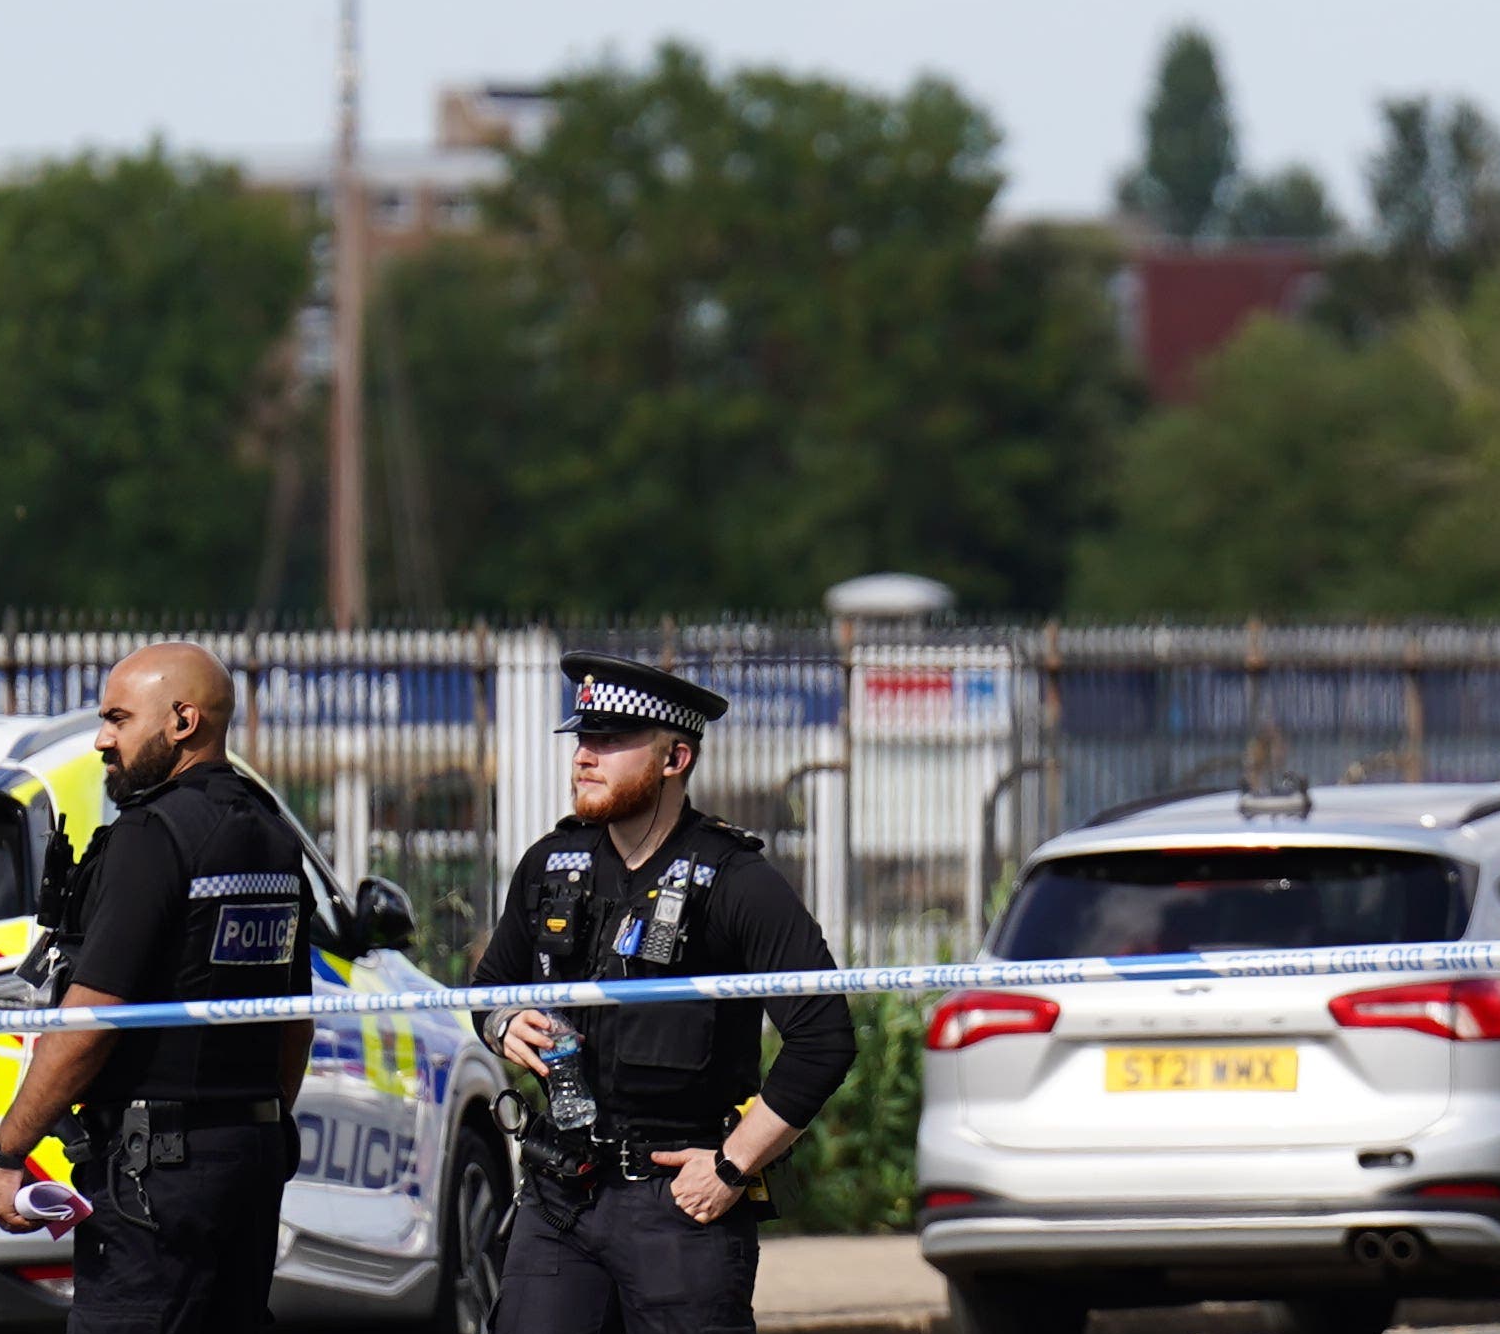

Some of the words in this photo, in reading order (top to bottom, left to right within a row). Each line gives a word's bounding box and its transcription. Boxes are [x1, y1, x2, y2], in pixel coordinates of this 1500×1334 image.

[221, 919, 298, 948] POLICE
[1227, 952, 1316, 977] CROSS
[1329, 949, 1377, 973] NOT
[1388, 947, 1424, 971] DO
[1437, 944, 1493, 970] LINE
[817, 971, 867, 992] NOT
[876, 969, 913, 990] DO
[924, 967, 980, 988] LINE
[990, 963, 1085, 984] POLICE
[716, 976, 803, 996] CROSS
[296, 1111, 417, 1191] OLICE
